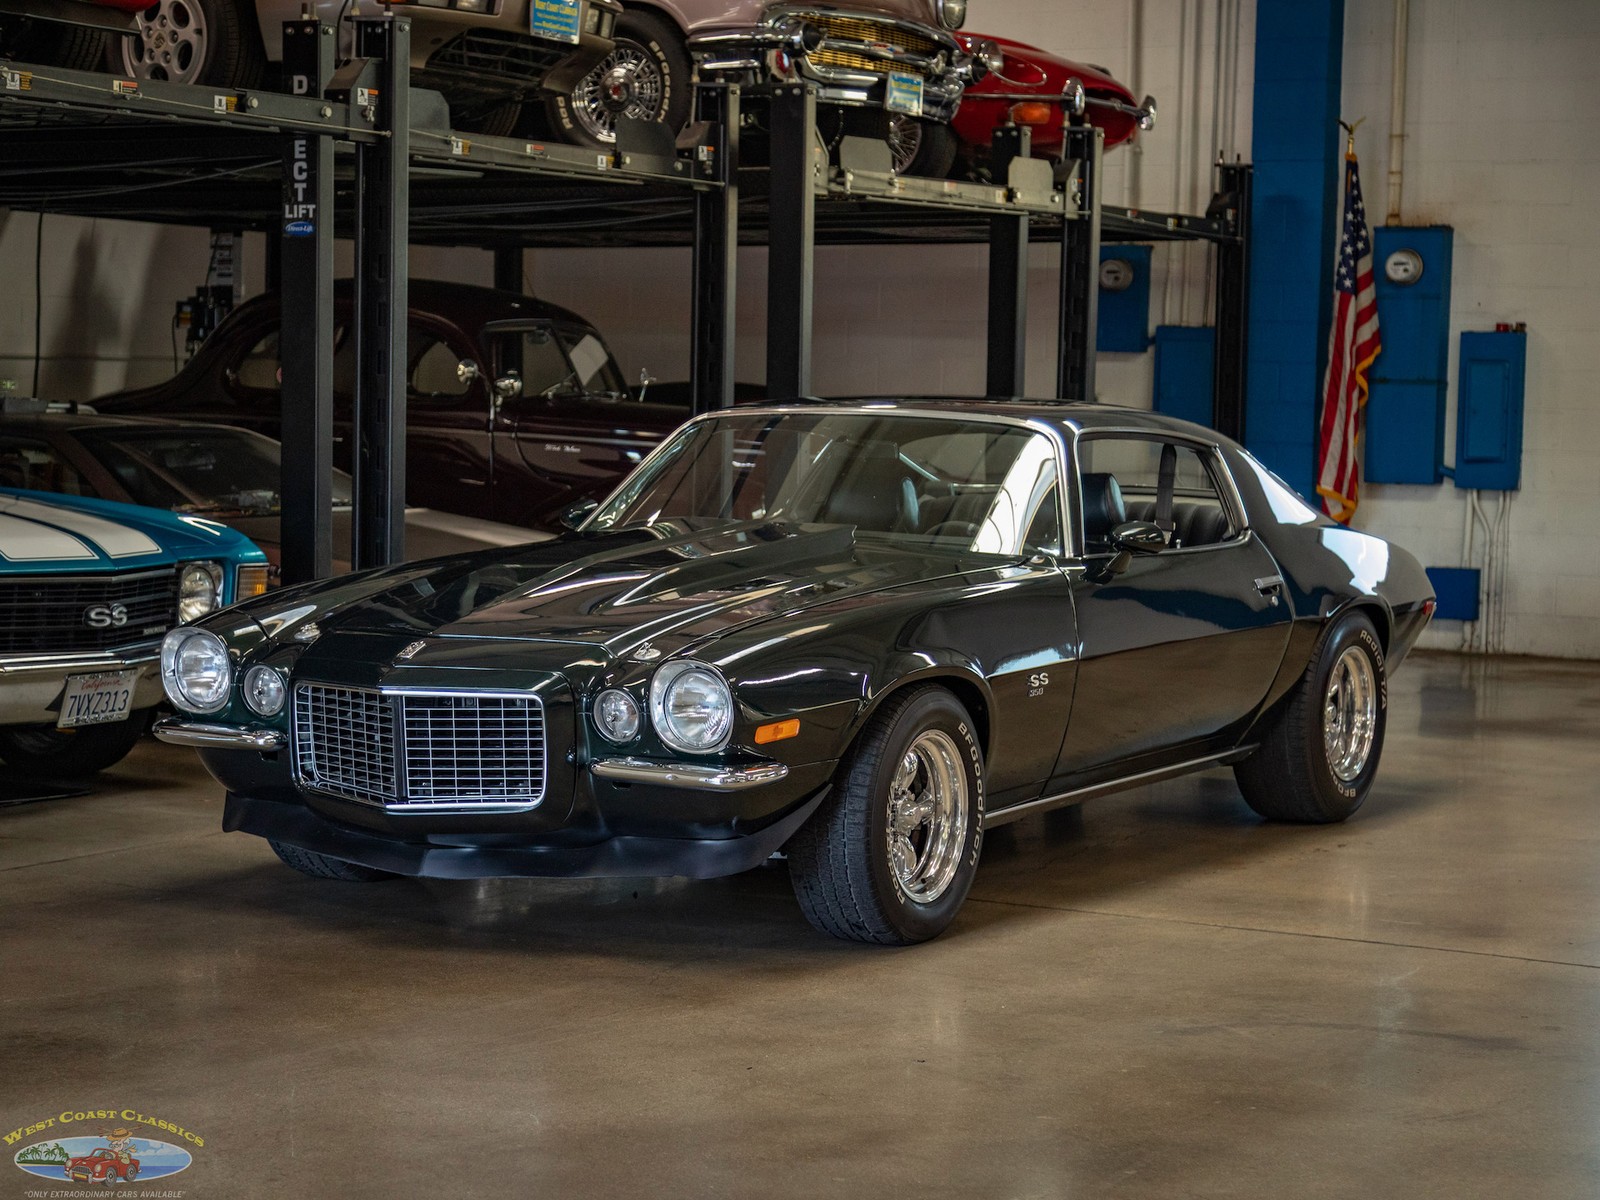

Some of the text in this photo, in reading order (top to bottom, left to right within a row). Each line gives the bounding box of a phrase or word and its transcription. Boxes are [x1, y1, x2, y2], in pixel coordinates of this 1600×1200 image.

[556, 96, 574, 129] Rad
[285, 204, 316, 218] LIFT
[85, 602, 128, 627] SS
[1360, 629, 1384, 672] Radial
[1029, 687, 1044, 698] 350
[1030, 672, 1049, 687] SS
[67, 688, 130, 719] 7VXZ313
[958, 721, 985, 867] BFGoodrich
